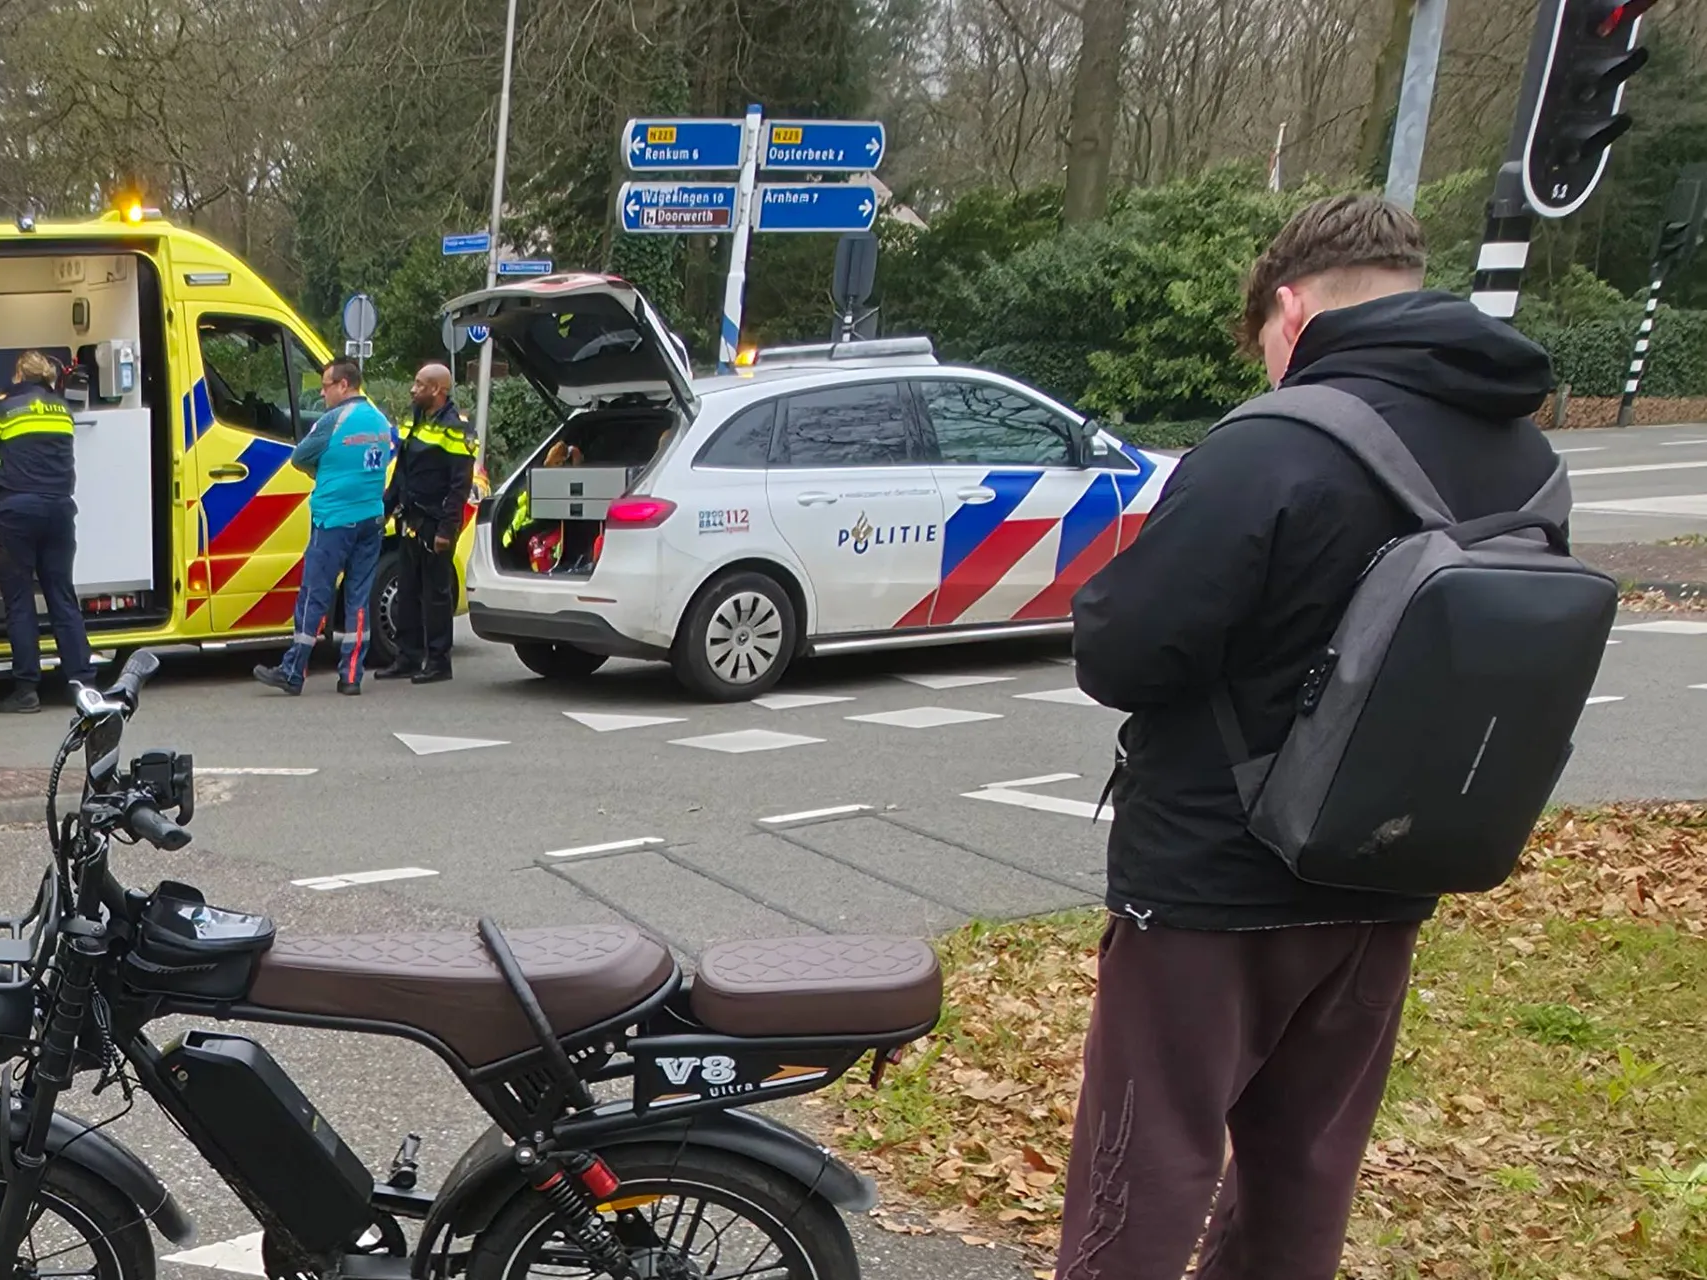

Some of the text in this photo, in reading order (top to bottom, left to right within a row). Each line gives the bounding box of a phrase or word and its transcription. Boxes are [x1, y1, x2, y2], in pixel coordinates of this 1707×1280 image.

[645, 147, 690, 160] Renkum
[769, 147, 835, 162] Oosterbeek
[713, 193, 724, 204] 10
[764, 190, 810, 203] Arnhem
[658, 209, 713, 223] Doorwerth
[726, 509, 749, 524] 112
[837, 524, 937, 555] POLITIE
[655, 1055, 736, 1085] V8
[709, 1082, 754, 1098] Ultra
